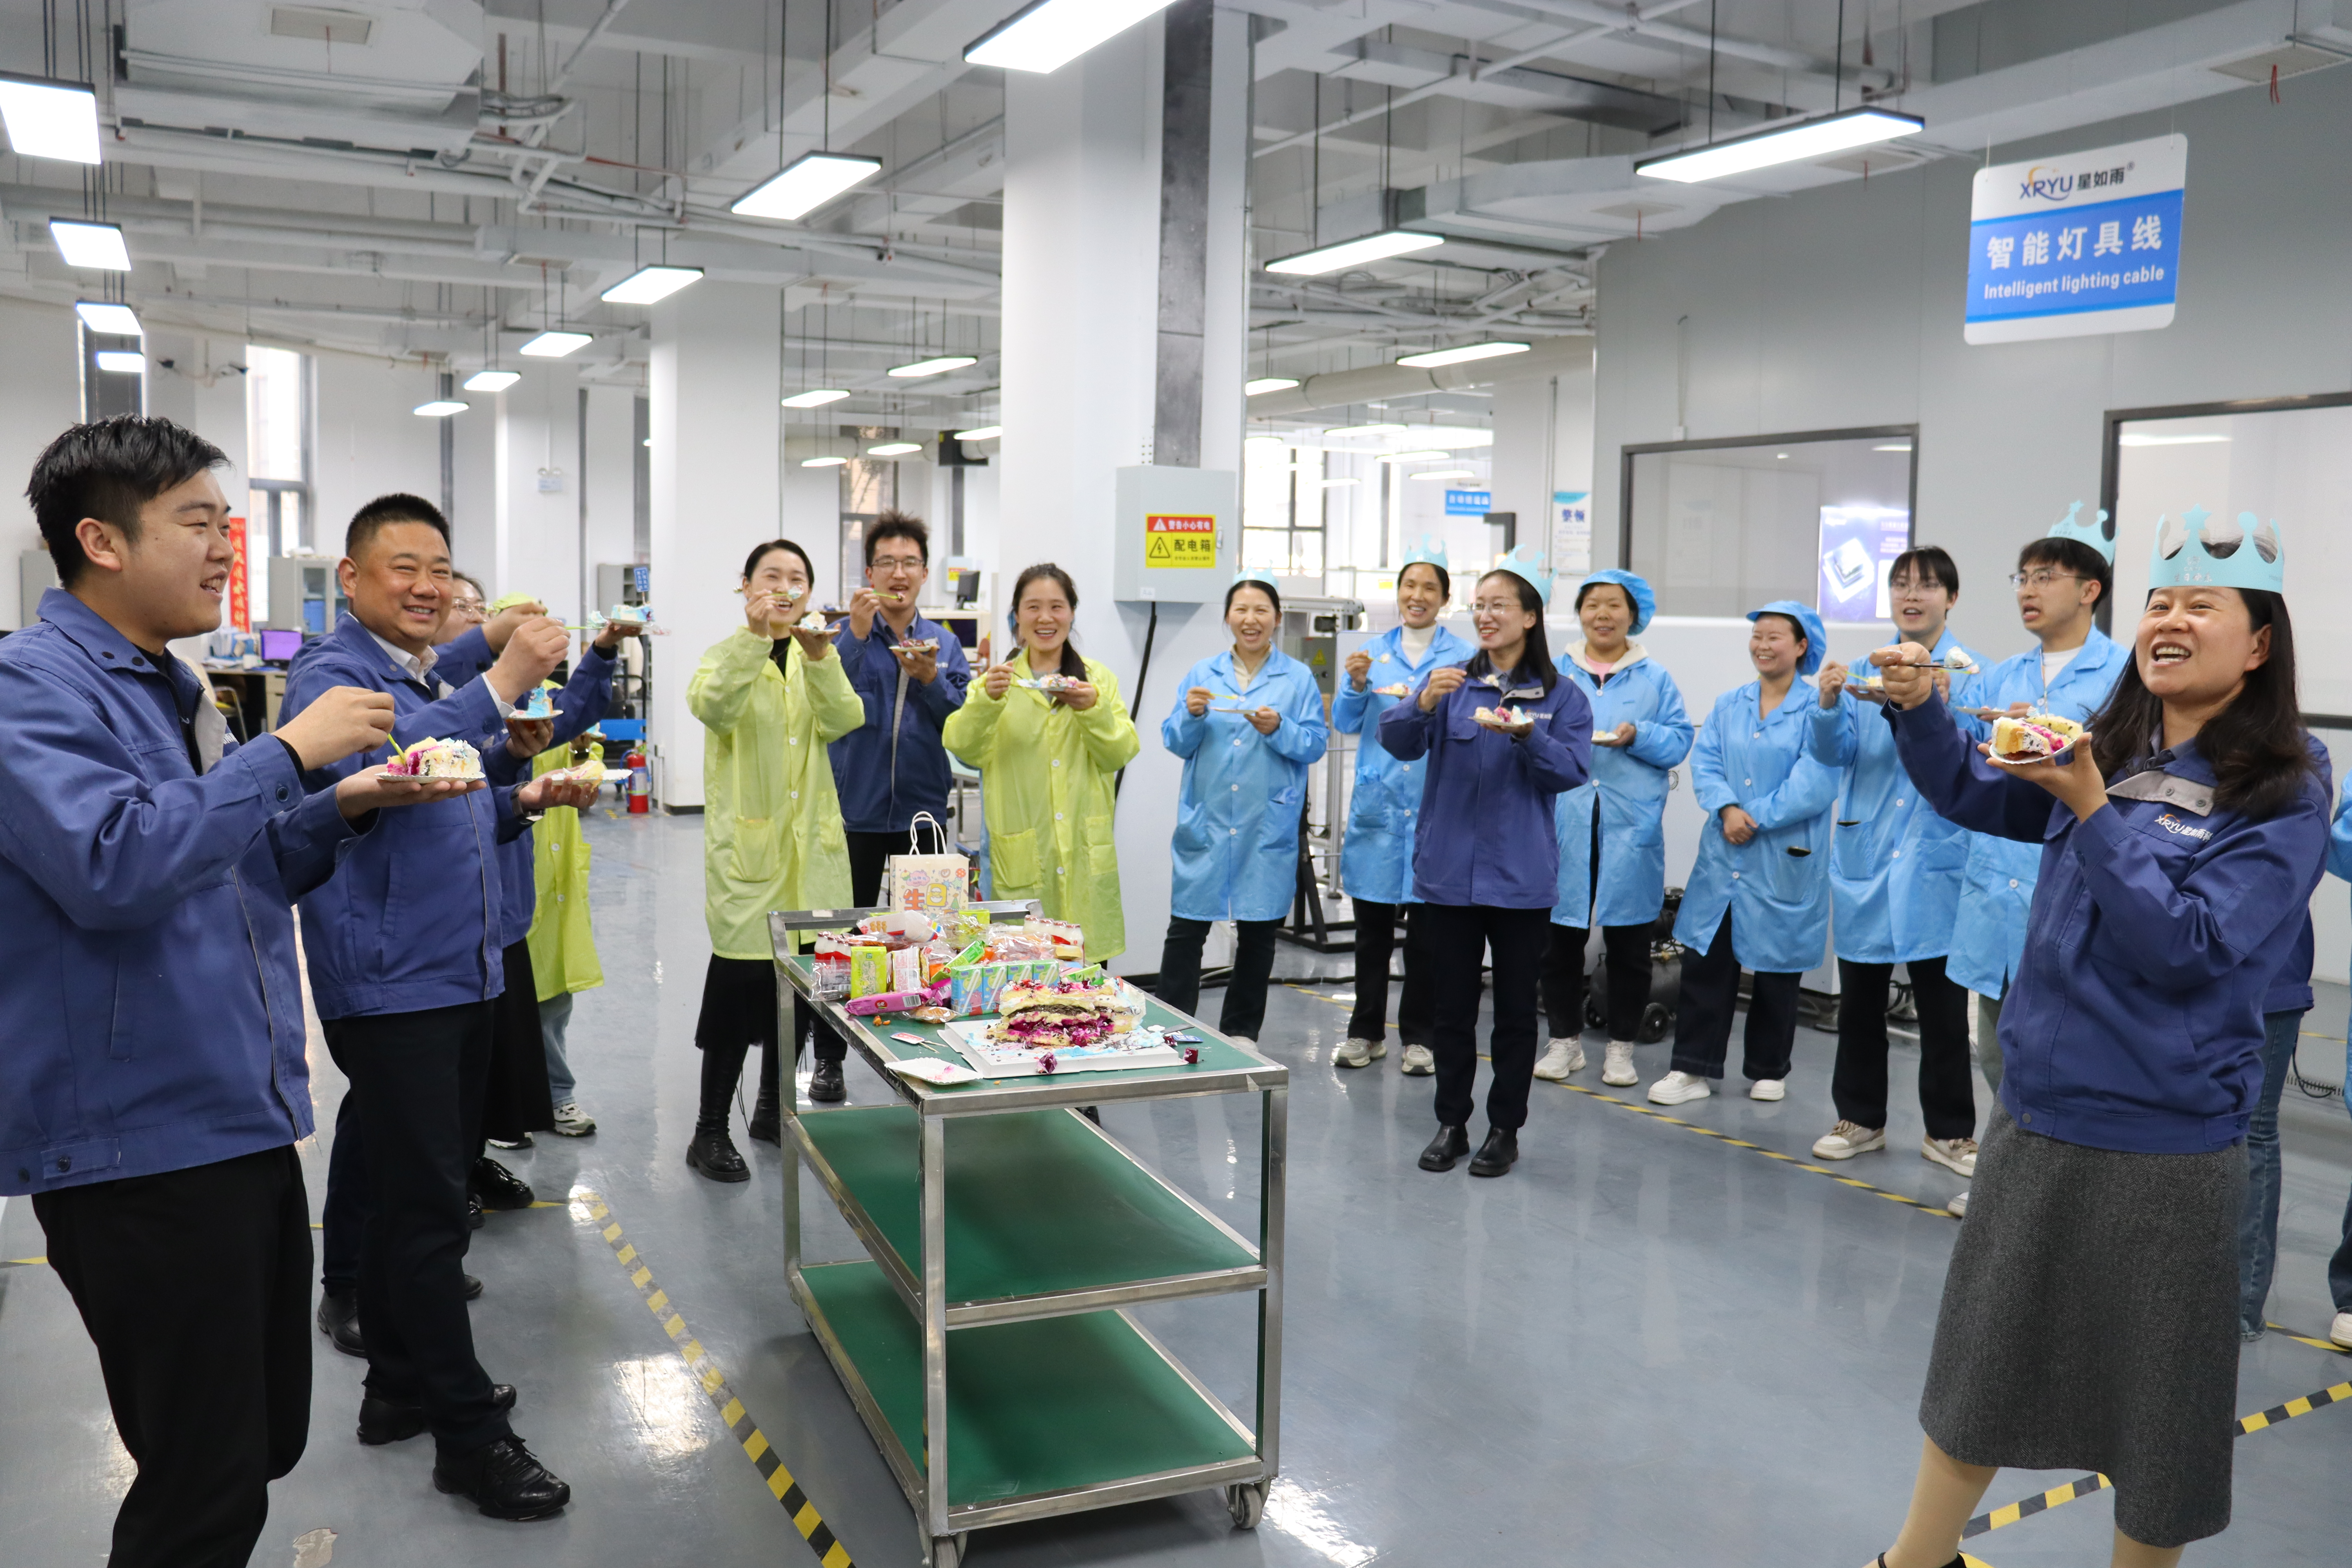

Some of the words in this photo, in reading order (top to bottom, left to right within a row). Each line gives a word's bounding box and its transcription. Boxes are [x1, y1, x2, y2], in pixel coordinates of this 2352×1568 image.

[2020, 175, 2073, 201] XRYU
[1986, 215, 2162, 270] 智能灯具线
[1984, 277, 2058, 299] Intelligent
[2061, 271, 2120, 294] lighting
[2123, 265, 2165, 285] cable
[1174, 539, 1210, 552] 配电箱
[2154, 815, 2185, 834] XRYU
